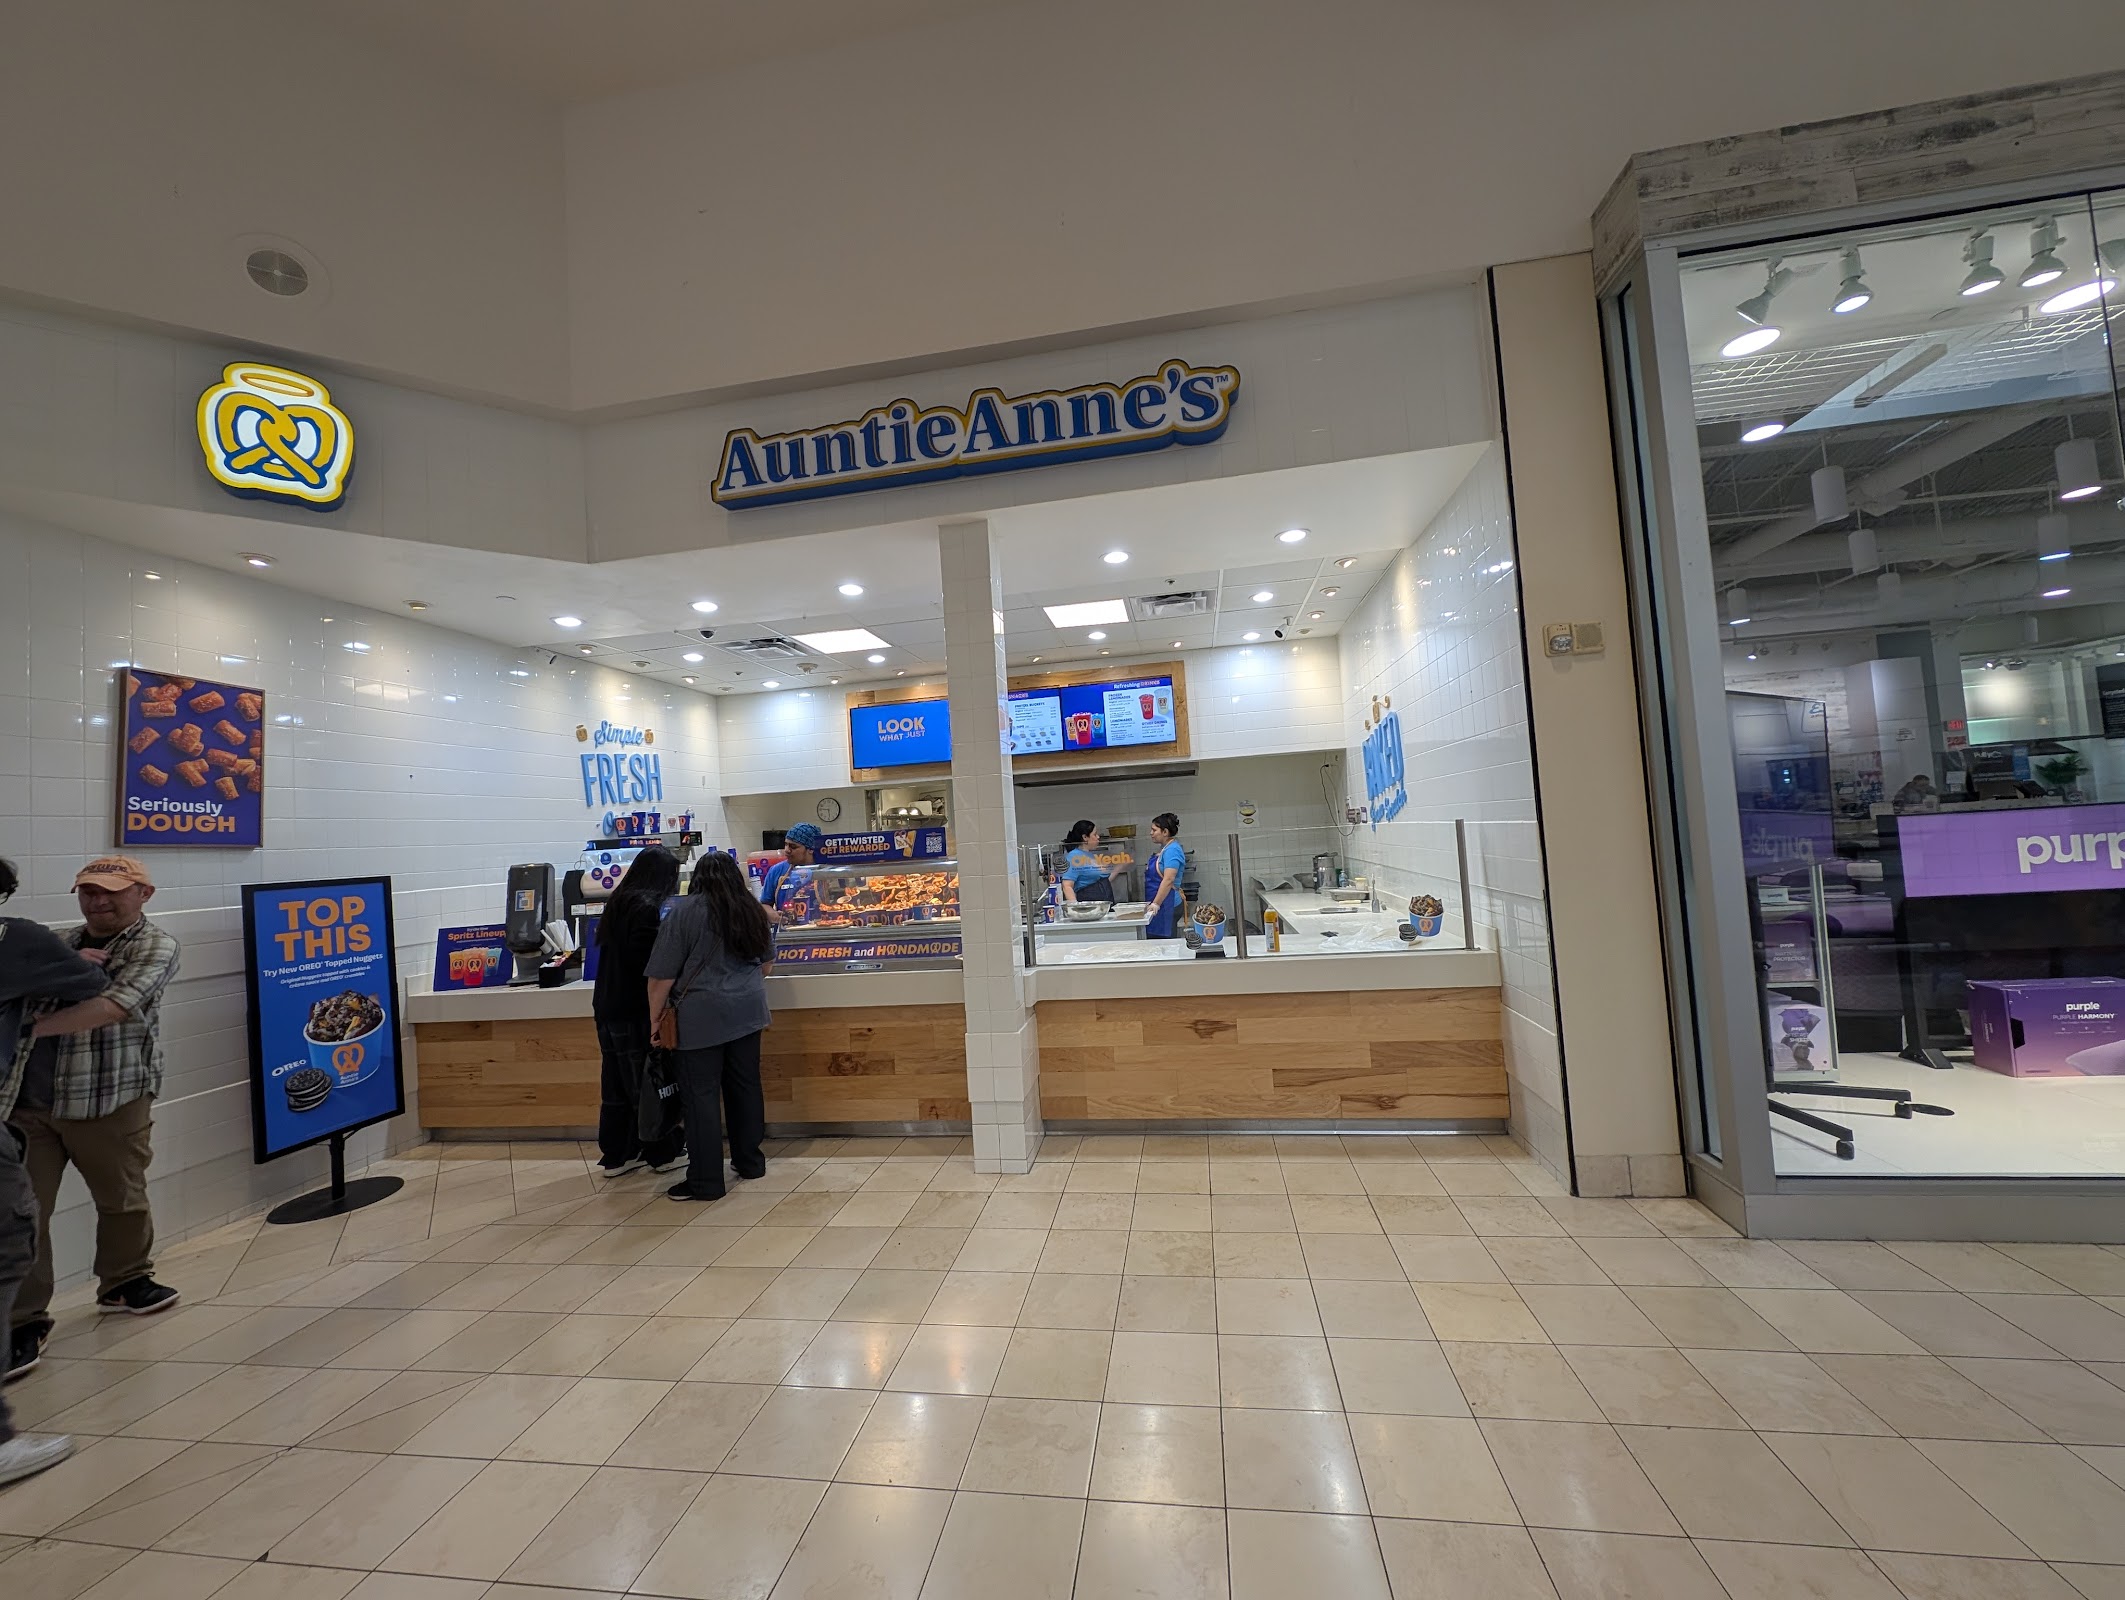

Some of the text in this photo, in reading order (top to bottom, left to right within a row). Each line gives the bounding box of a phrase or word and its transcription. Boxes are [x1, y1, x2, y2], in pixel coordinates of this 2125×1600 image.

[719, 406, 956, 491] Auntie
[962, 367, 1218, 454] Anne's
[594, 719, 644, 748] Simple
[877, 716, 925, 734] LOOK
[879, 730, 925, 742] WHAT JUST
[580, 753, 663, 807] FRESH
[128, 796, 223, 817] Seriously
[127, 813, 236, 833] DOUGH
[820, 846, 838, 855] GET
[839, 842, 890, 854] REWARDED
[825, 835, 885, 847] GET TWISTED
[1093, 852, 1134, 865] Yeah.
[278, 895, 366, 930] TOP
[274, 923, 372, 962] THIS
[448, 932, 475, 941] Spritz
[476, 930, 506, 938] Lineup
[778, 949, 808, 961] HOT,
[811, 946, 852, 959] FRESH
[854, 947, 875, 957] and
[263, 969, 278, 977] Try
[279, 966, 297, 975] New
[325, 957, 352, 967] Topped
[353, 953, 383, 963] Nuggets
[2066, 1001, 2100, 1012] purple
[272, 1059, 306, 1077] OREO
